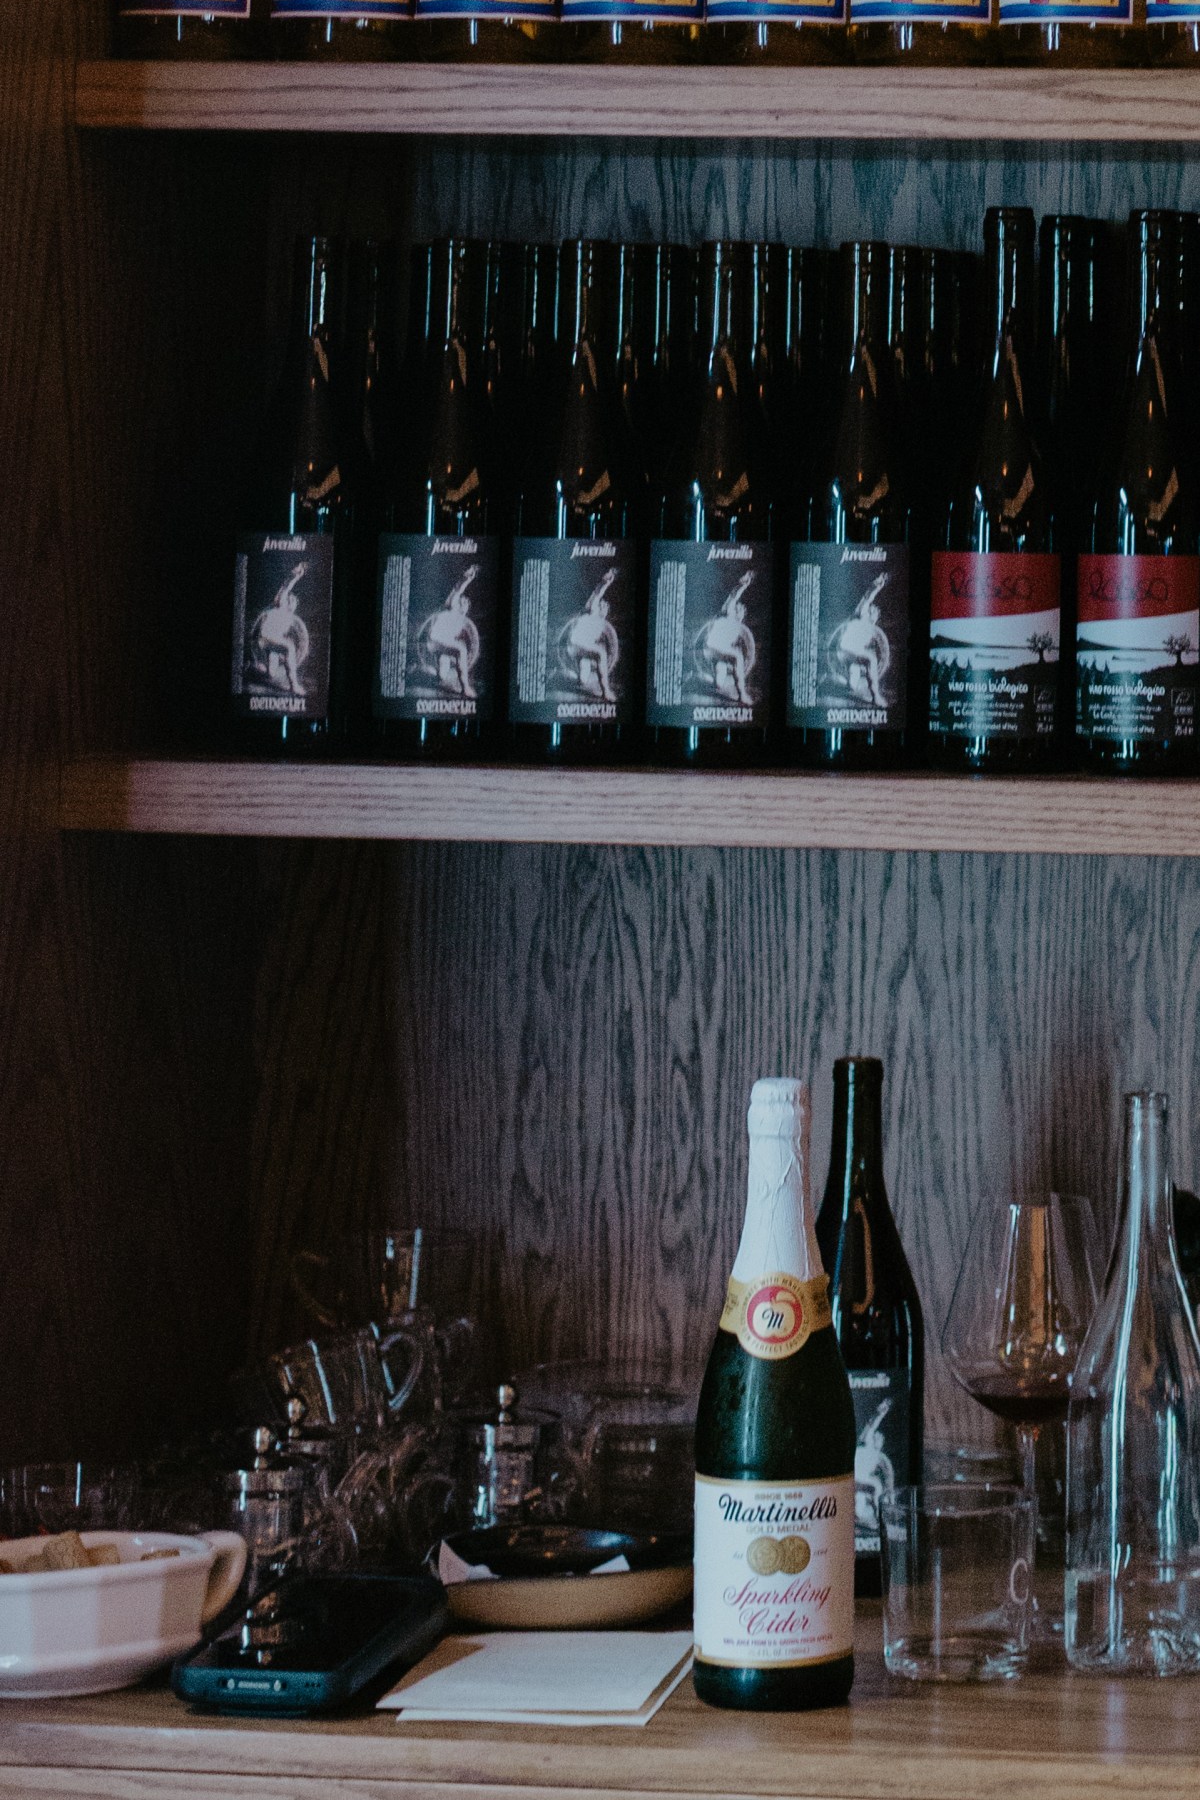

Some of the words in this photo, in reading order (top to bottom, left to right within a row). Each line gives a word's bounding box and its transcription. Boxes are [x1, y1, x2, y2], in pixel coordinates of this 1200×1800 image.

[948, 681, 964, 693] vino
[965, 682, 987, 693] rosso
[988, 677, 1028, 699] biologico
[1089, 685, 1103, 695] vino
[1103, 686, 1123, 696] rosso
[1123, 681, 1165, 702] biologico
[761, 1306, 784, 1329] M
[719, 1494, 837, 1523] Martinelli's
[777, 1523, 812, 1534] MEDAL
[723, 1577, 832, 1611] Sparkling
[739, 1608, 810, 1636] Cider
